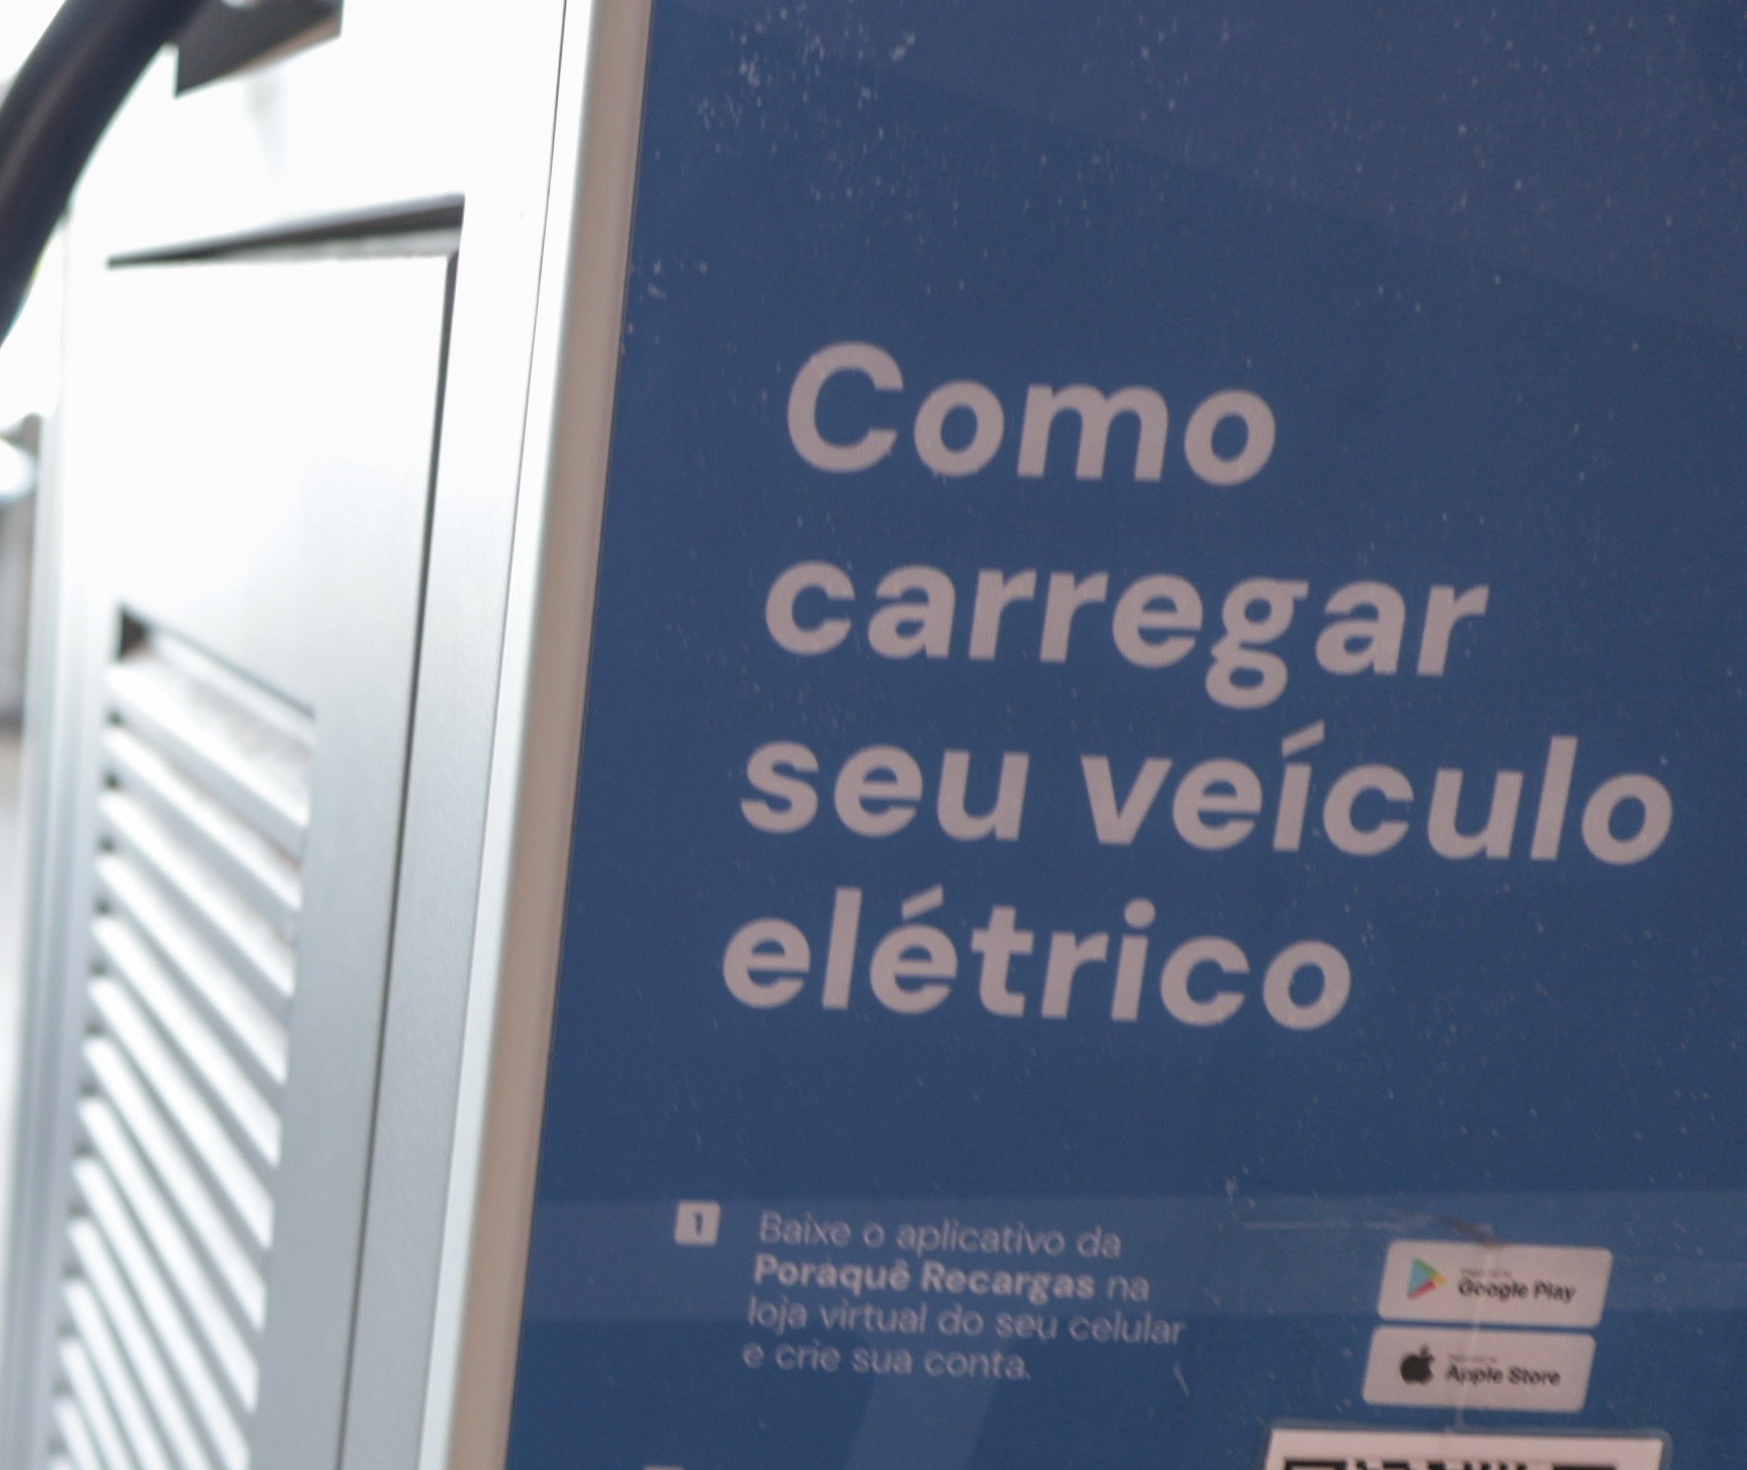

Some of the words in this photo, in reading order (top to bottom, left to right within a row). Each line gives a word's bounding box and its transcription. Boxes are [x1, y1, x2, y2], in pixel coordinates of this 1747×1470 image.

[786, 341, 1277, 485] Como
[765, 560, 1490, 710] carregar
[741, 741, 1029, 841] seu
[1081, 720, 1673, 866] veículo
[722, 885, 1352, 1030] elétrico
[760, 1211, 850, 1247] Baixe
[863, 1223, 885, 1248] o
[897, 1220, 1064, 1265] aplicativo
[1077, 1225, 1122, 1258] da
[754, 1253, 910, 1295] Poraquê
[921, 1259, 1095, 1305] Recargas
[1108, 1276, 1150, 1301] na
[1459, 1279, 1529, 1301] Google
[1534, 1280, 1576, 1304] Play
[748, 1295, 807, 1336] loja
[820, 1301, 927, 1334] virtual
[938, 1304, 984, 1337] do
[995, 1314, 1058, 1341] seu
[1070, 1312, 1186, 1345] celular
[743, 1344, 765, 1369] e
[775, 1341, 841, 1371] crie
[852, 1348, 912, 1375] sua
[924, 1349, 1031, 1380] conta.
[1448, 1364, 1503, 1384] Apple
[1508, 1366, 1561, 1385] Store
